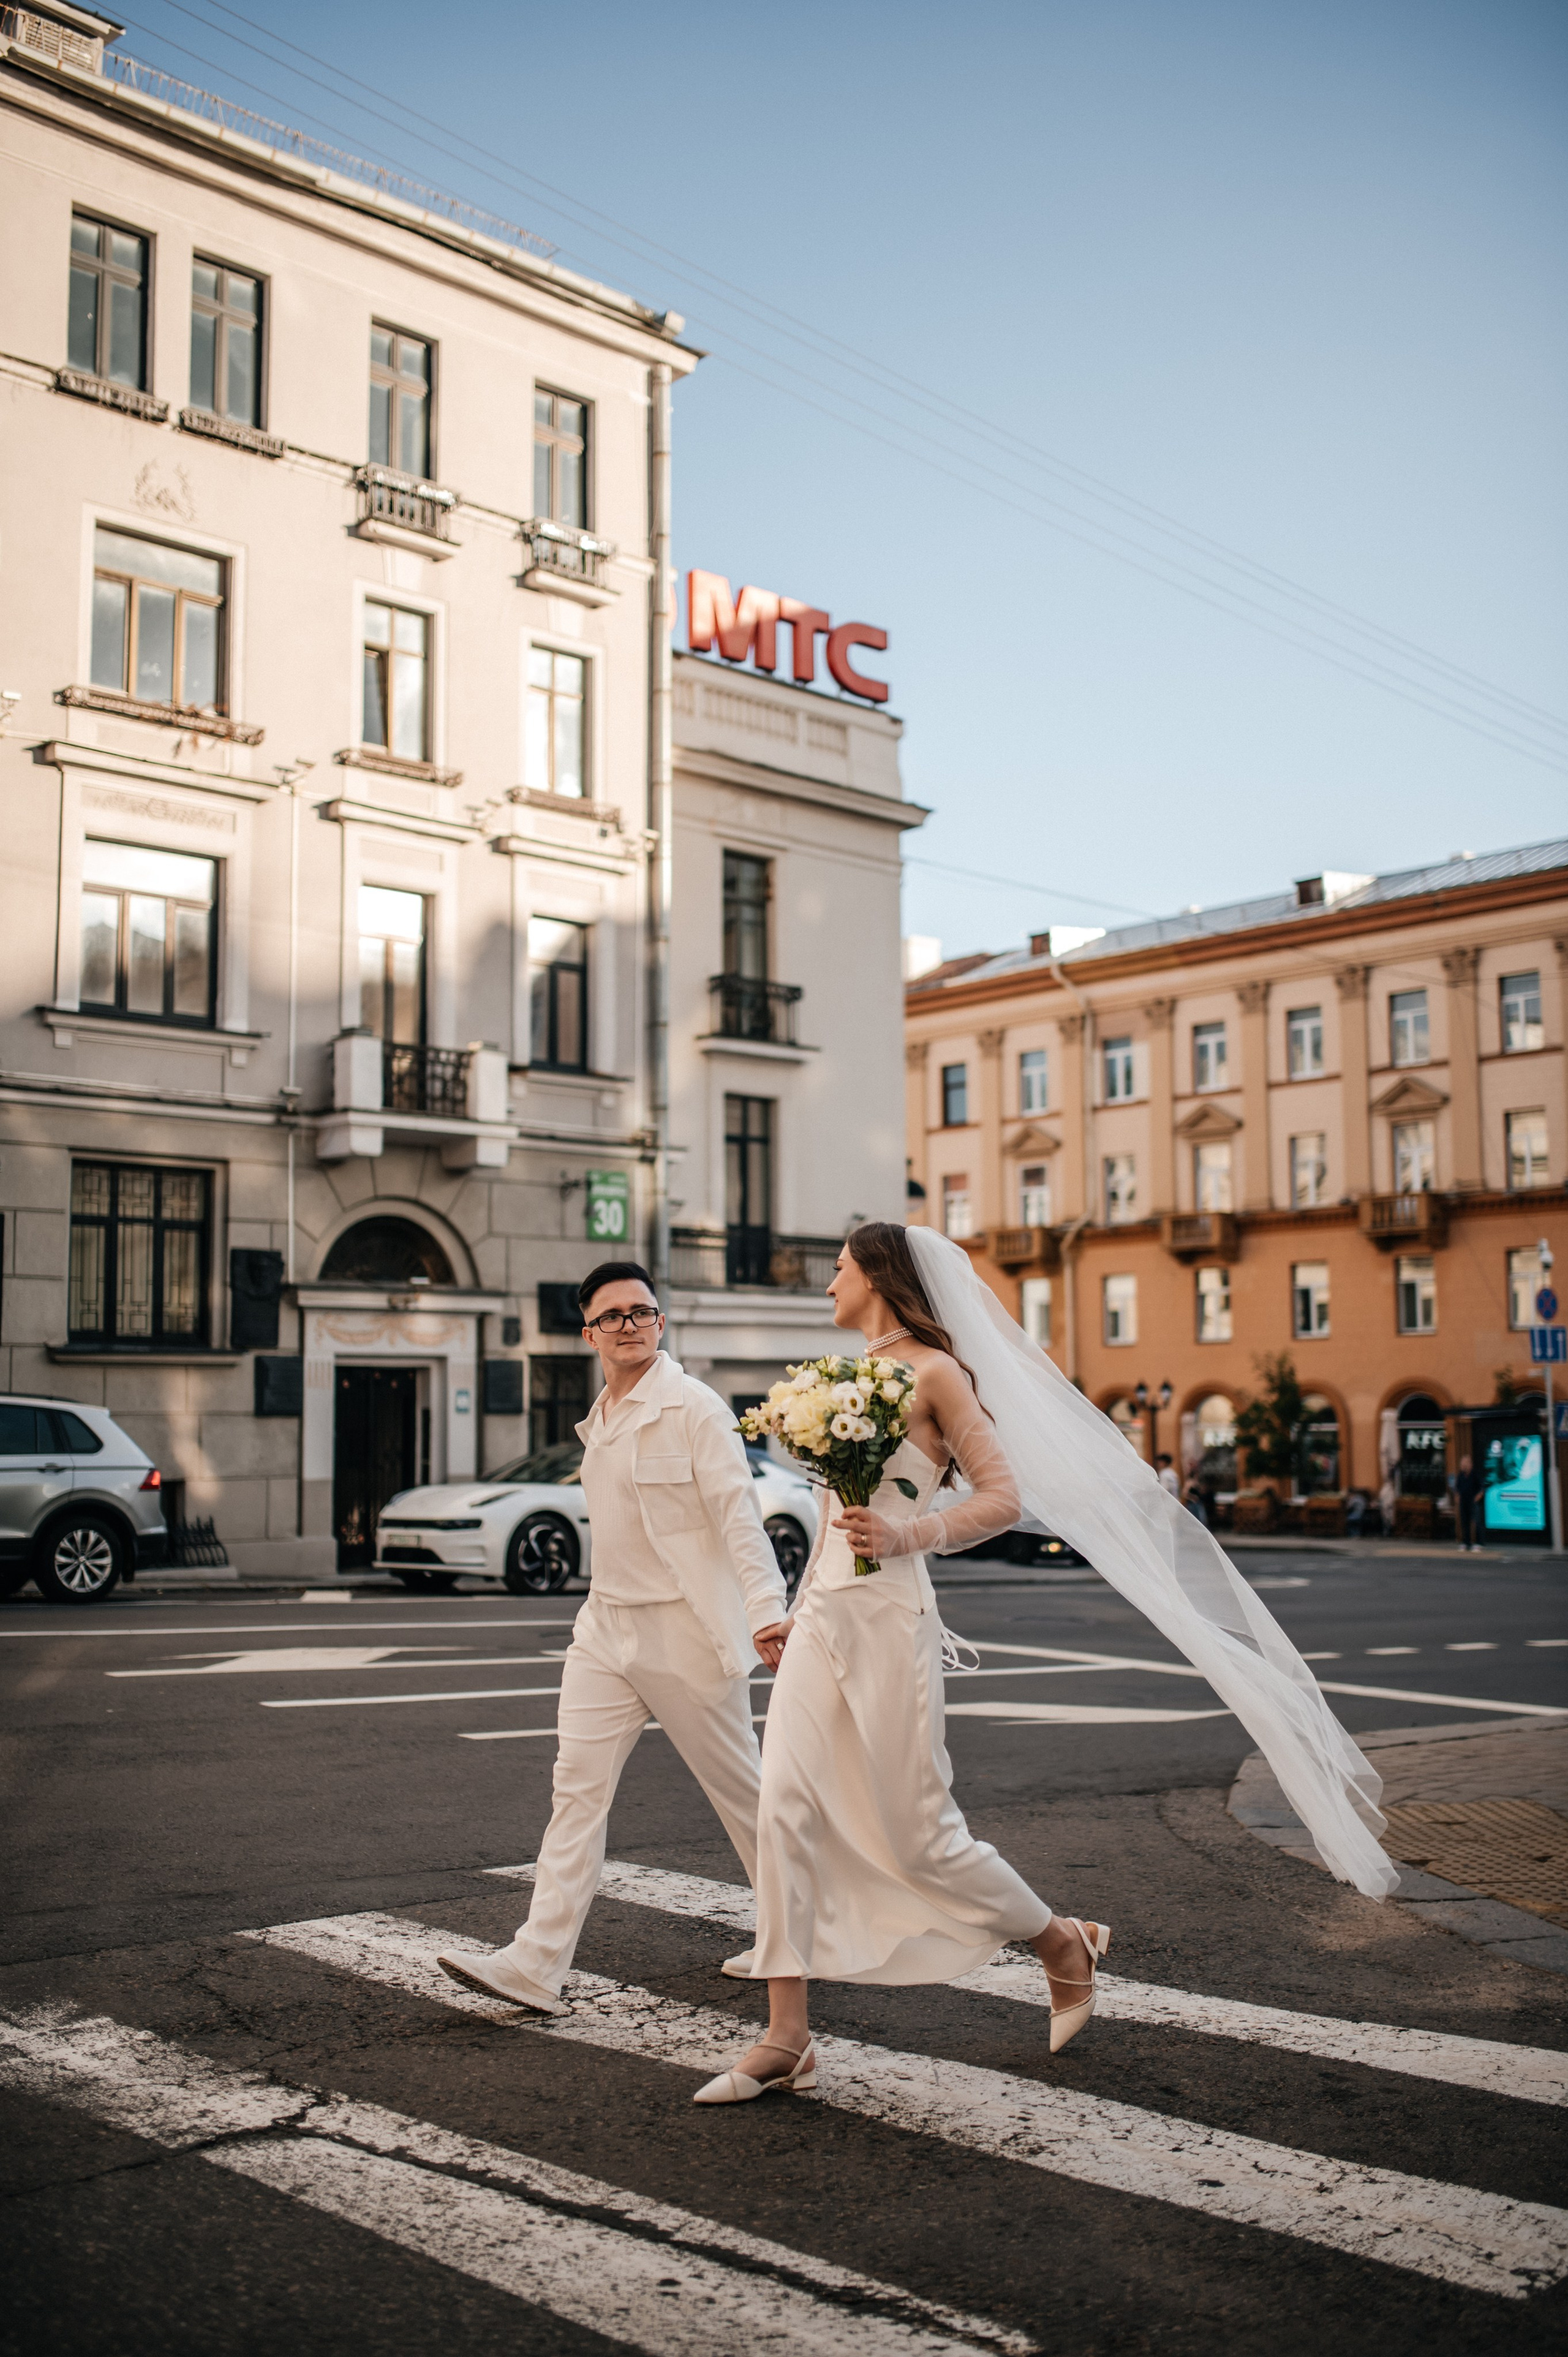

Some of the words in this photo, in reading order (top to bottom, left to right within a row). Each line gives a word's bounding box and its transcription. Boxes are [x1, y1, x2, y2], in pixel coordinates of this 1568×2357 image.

[688, 568, 889, 703] МТС
[593, 1199, 624, 1236] 30
[1406, 1430, 1447, 1450] KFC
